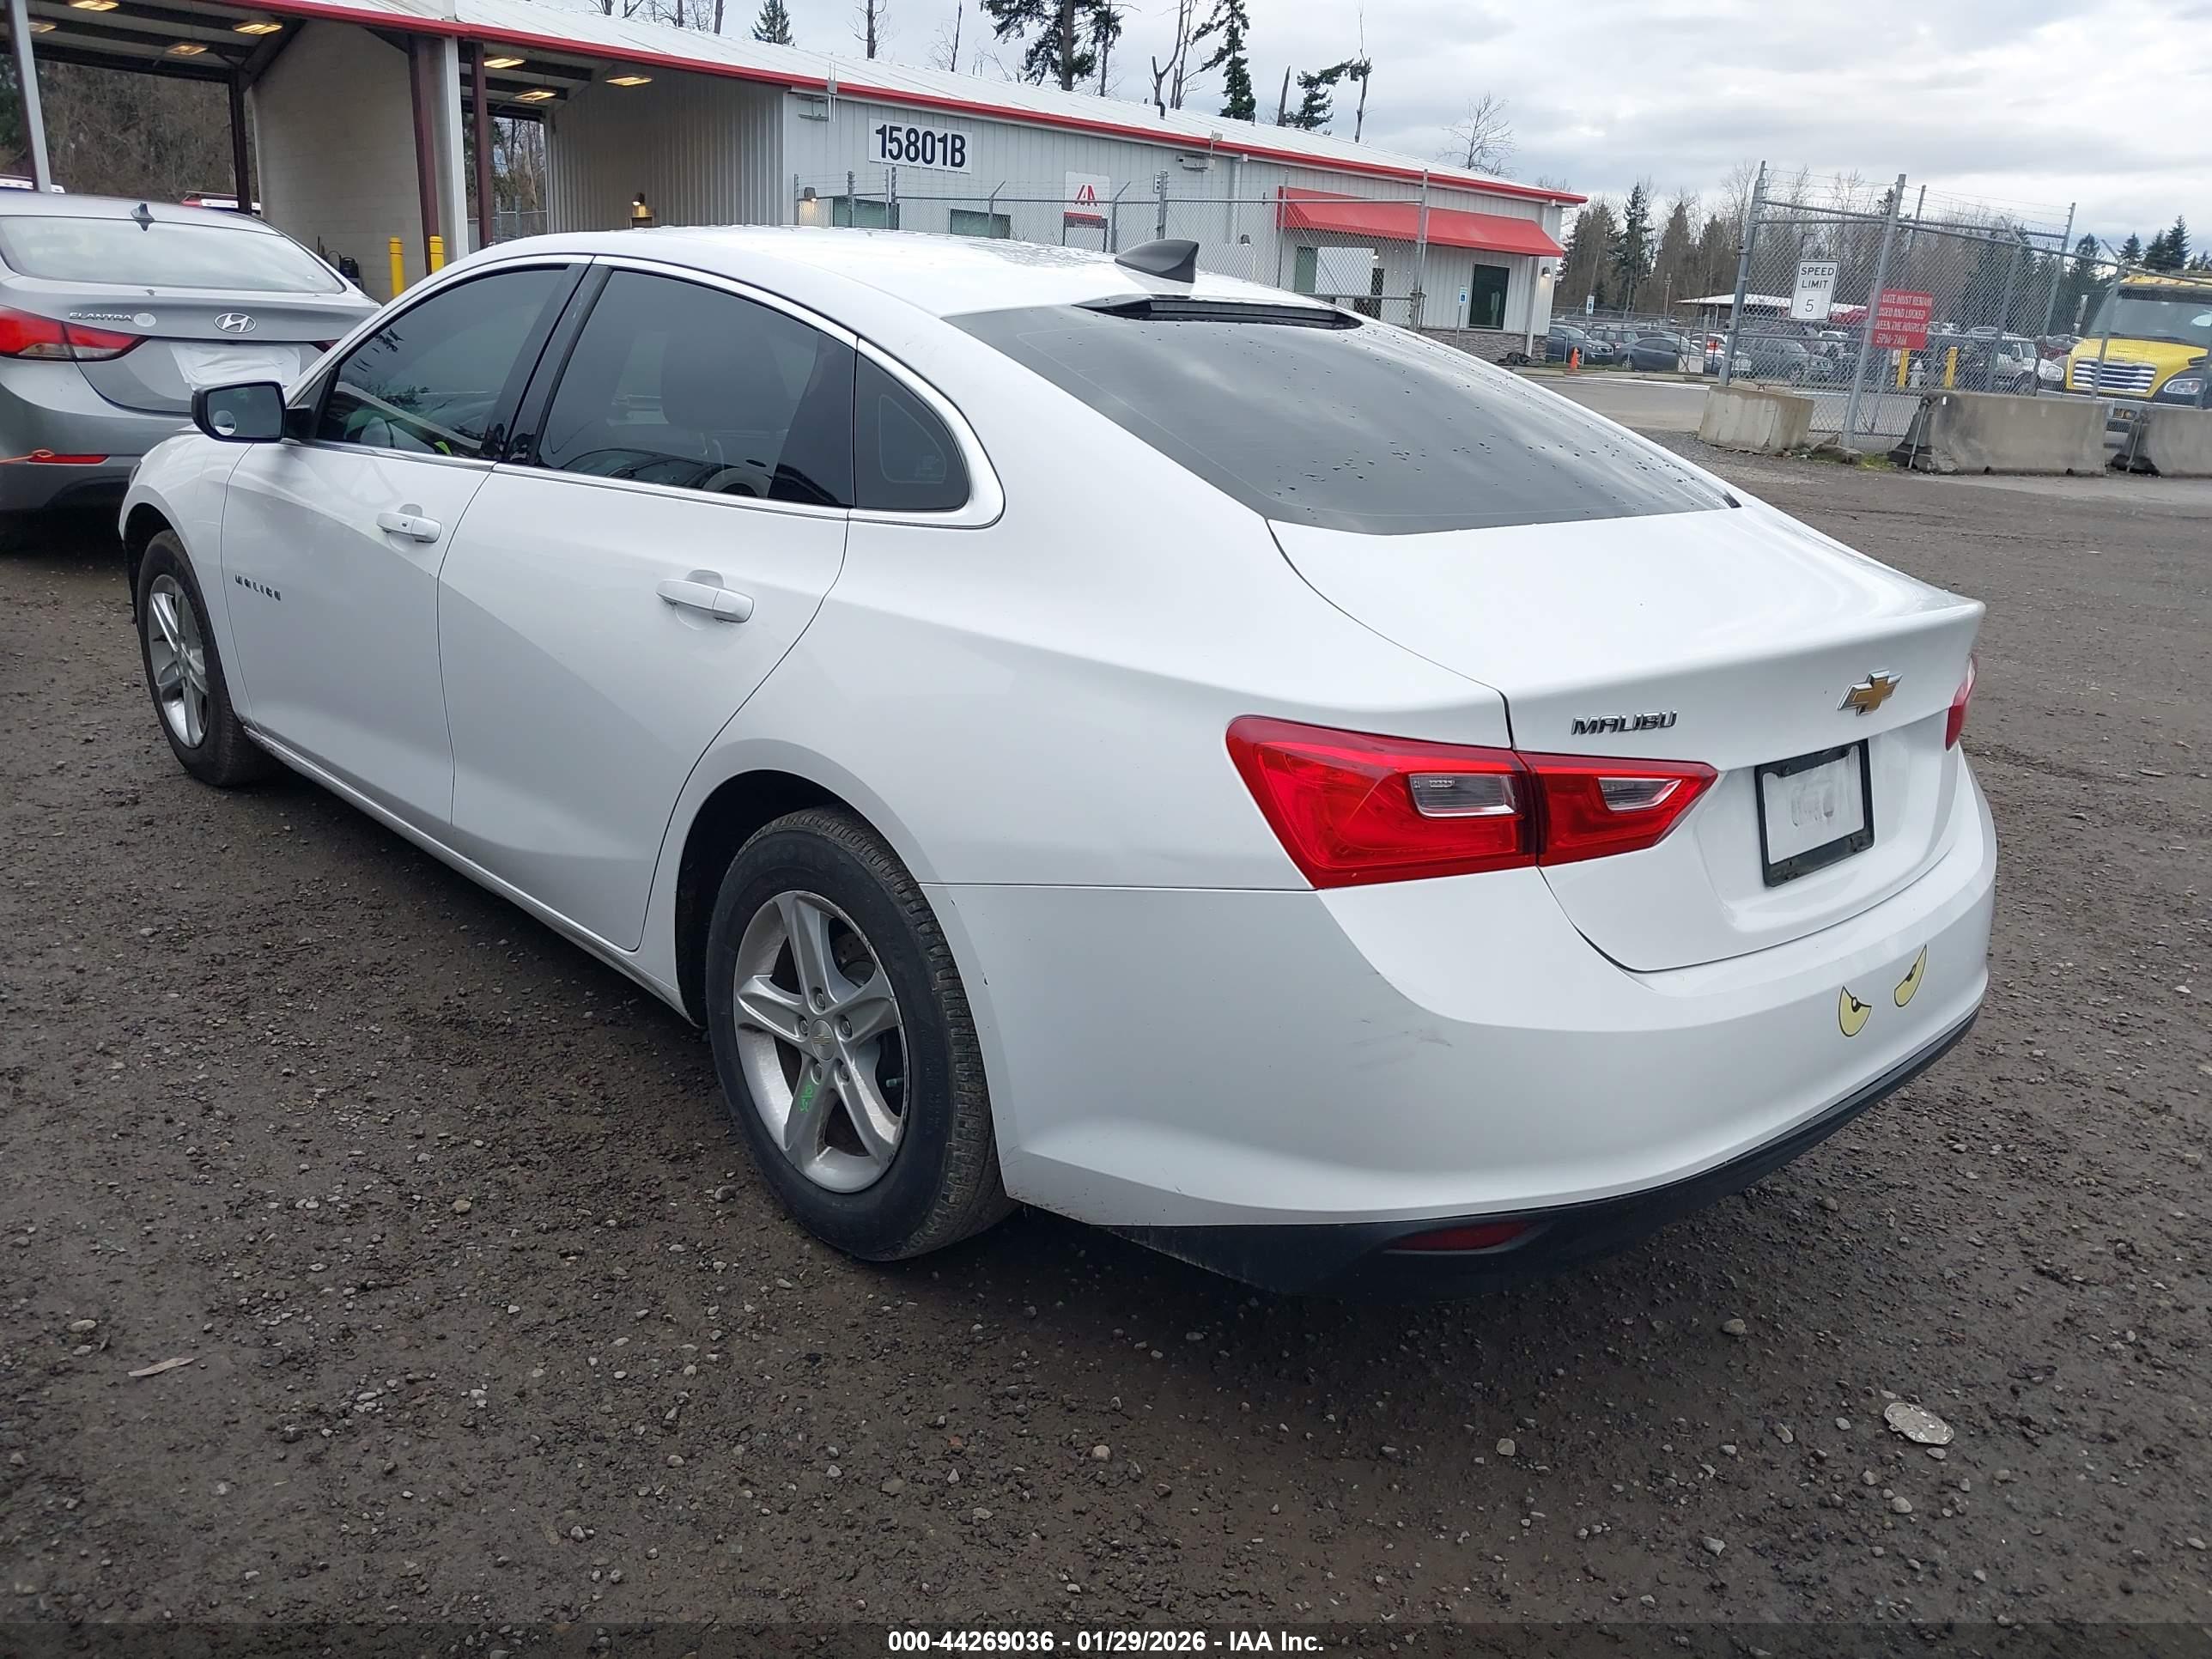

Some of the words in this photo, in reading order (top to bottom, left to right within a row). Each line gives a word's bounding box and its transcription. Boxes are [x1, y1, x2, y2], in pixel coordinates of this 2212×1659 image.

[875, 125, 966, 167] 15801B
[1801, 267, 1834, 276] SPEED
[1802, 280, 1829, 289] LIMIT
[1805, 299, 1814, 313] 5
[69, 312, 132, 322] ELANTRA
[1571, 710, 1677, 735] MALIBU
